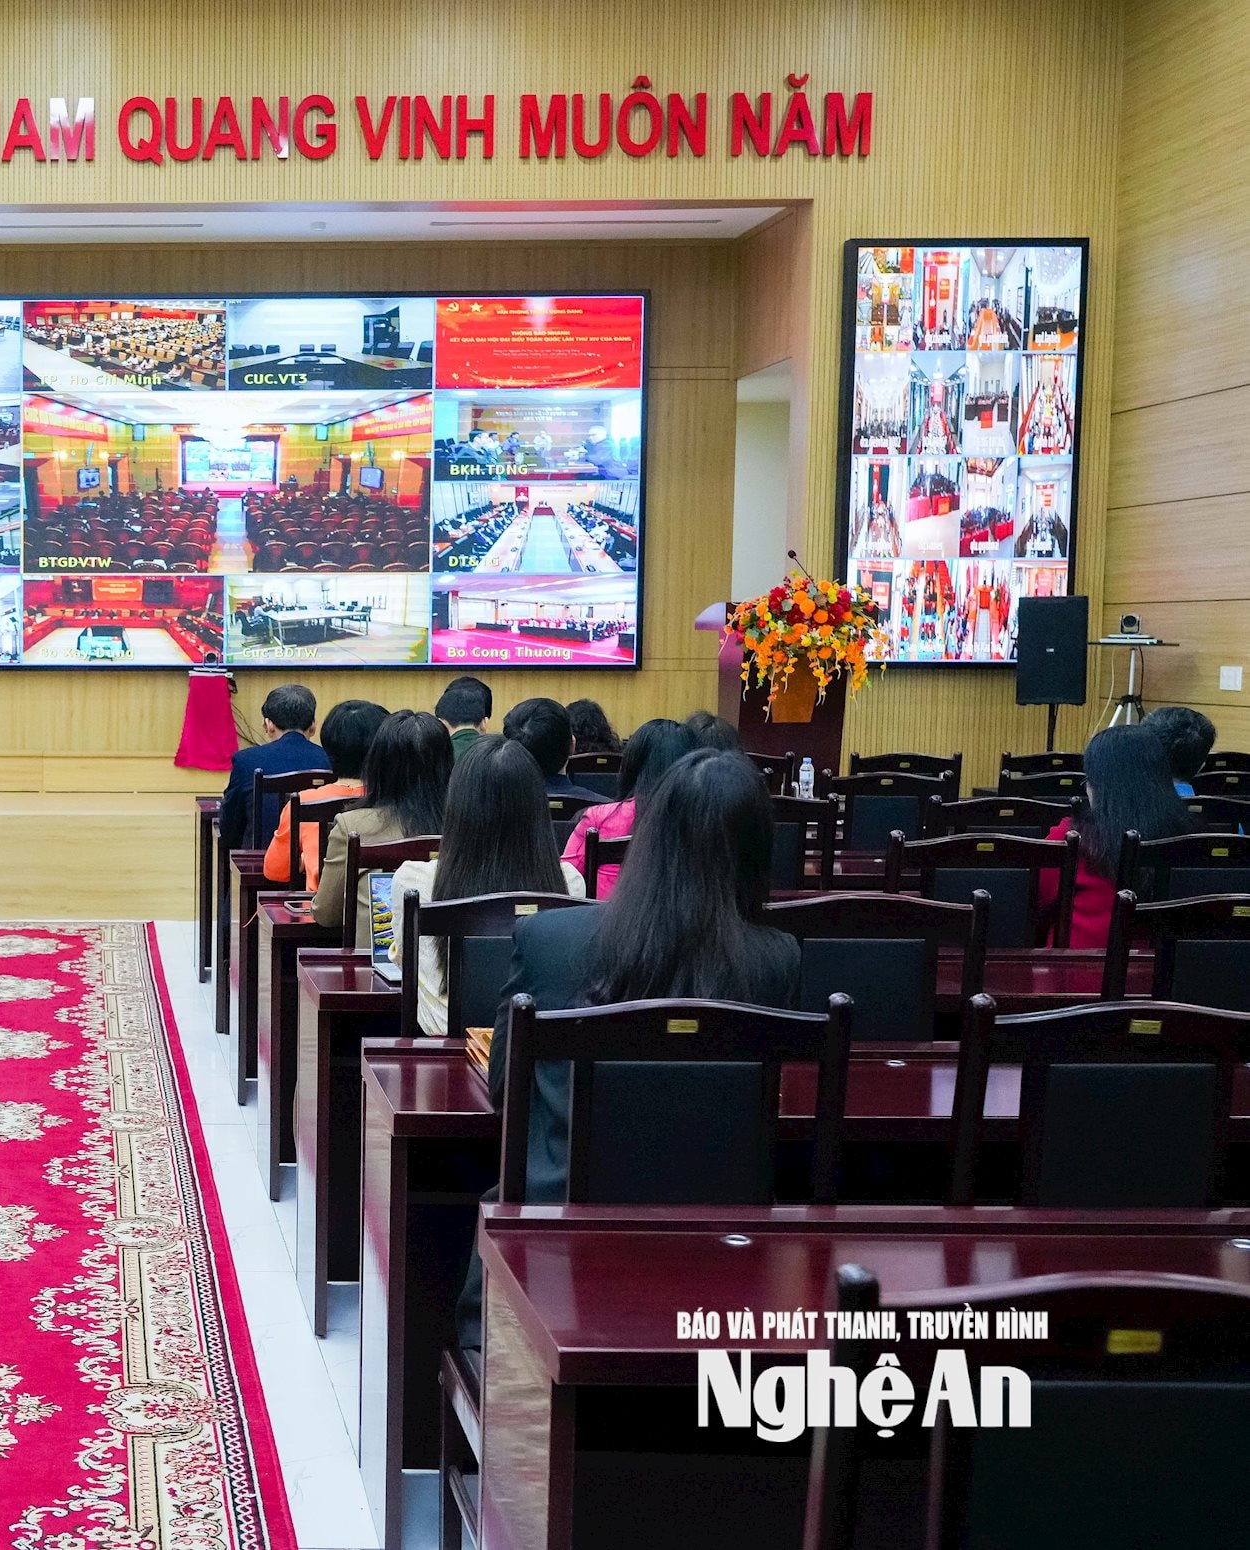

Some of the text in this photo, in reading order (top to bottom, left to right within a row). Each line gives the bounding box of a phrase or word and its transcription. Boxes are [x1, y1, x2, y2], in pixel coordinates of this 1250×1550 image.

[117, 94, 338, 165] QUANG
[355, 94, 495, 159] VINH
[519, 75, 708, 158] MUÔN
[730, 73, 874, 156] NĂM
[124, 373, 161, 385] Minh
[244, 373, 308, 385] CUC.VT3
[450, 464, 528, 476] BKH.TDNG
[38, 556, 112, 568] BTGDVTW
[448, 646, 572, 661] Bo Cong Thuong
